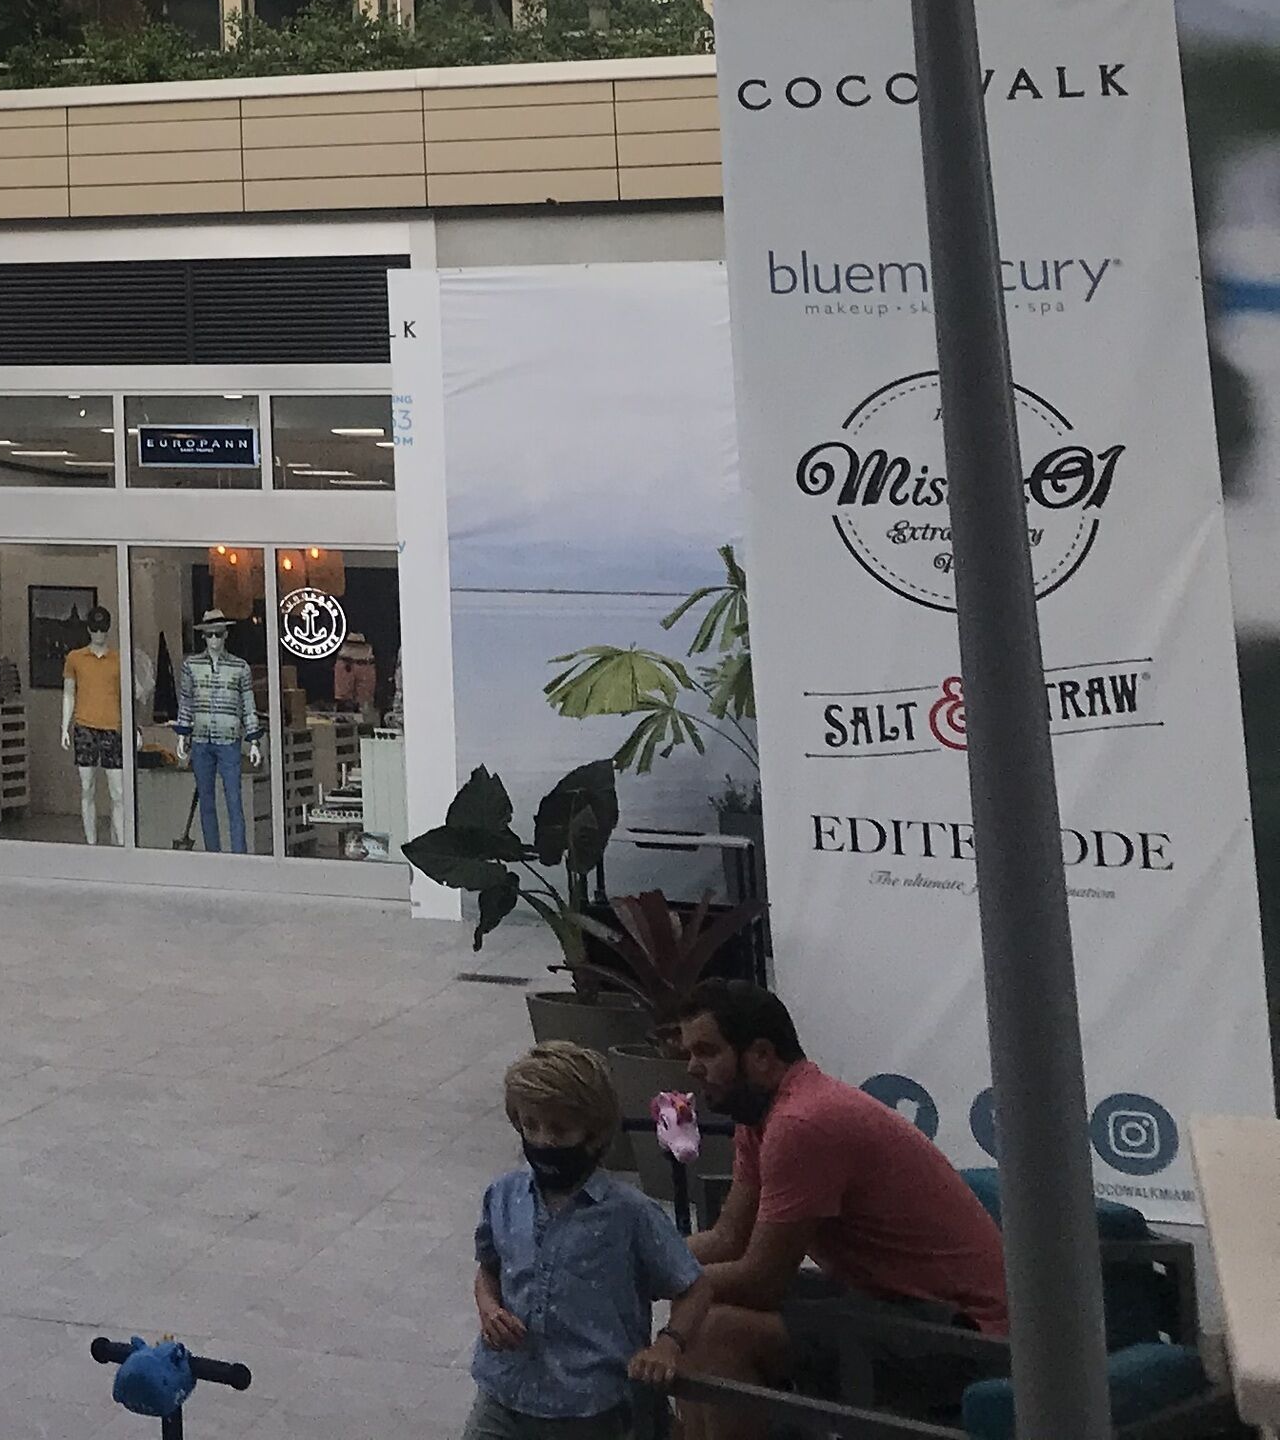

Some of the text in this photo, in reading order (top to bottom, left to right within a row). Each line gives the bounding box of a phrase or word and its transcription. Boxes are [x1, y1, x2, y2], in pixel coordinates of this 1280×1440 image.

[737, 63, 1129, 111] COCOALK
[768, 249, 1111, 303] bluemcury
[804, 300, 889, 316] makeup
[1028, 299, 1065, 316] spa
[146, 439, 249, 449] EUROPANN
[824, 701, 918, 748] SALT
[1060, 828, 1174, 871] ODE
